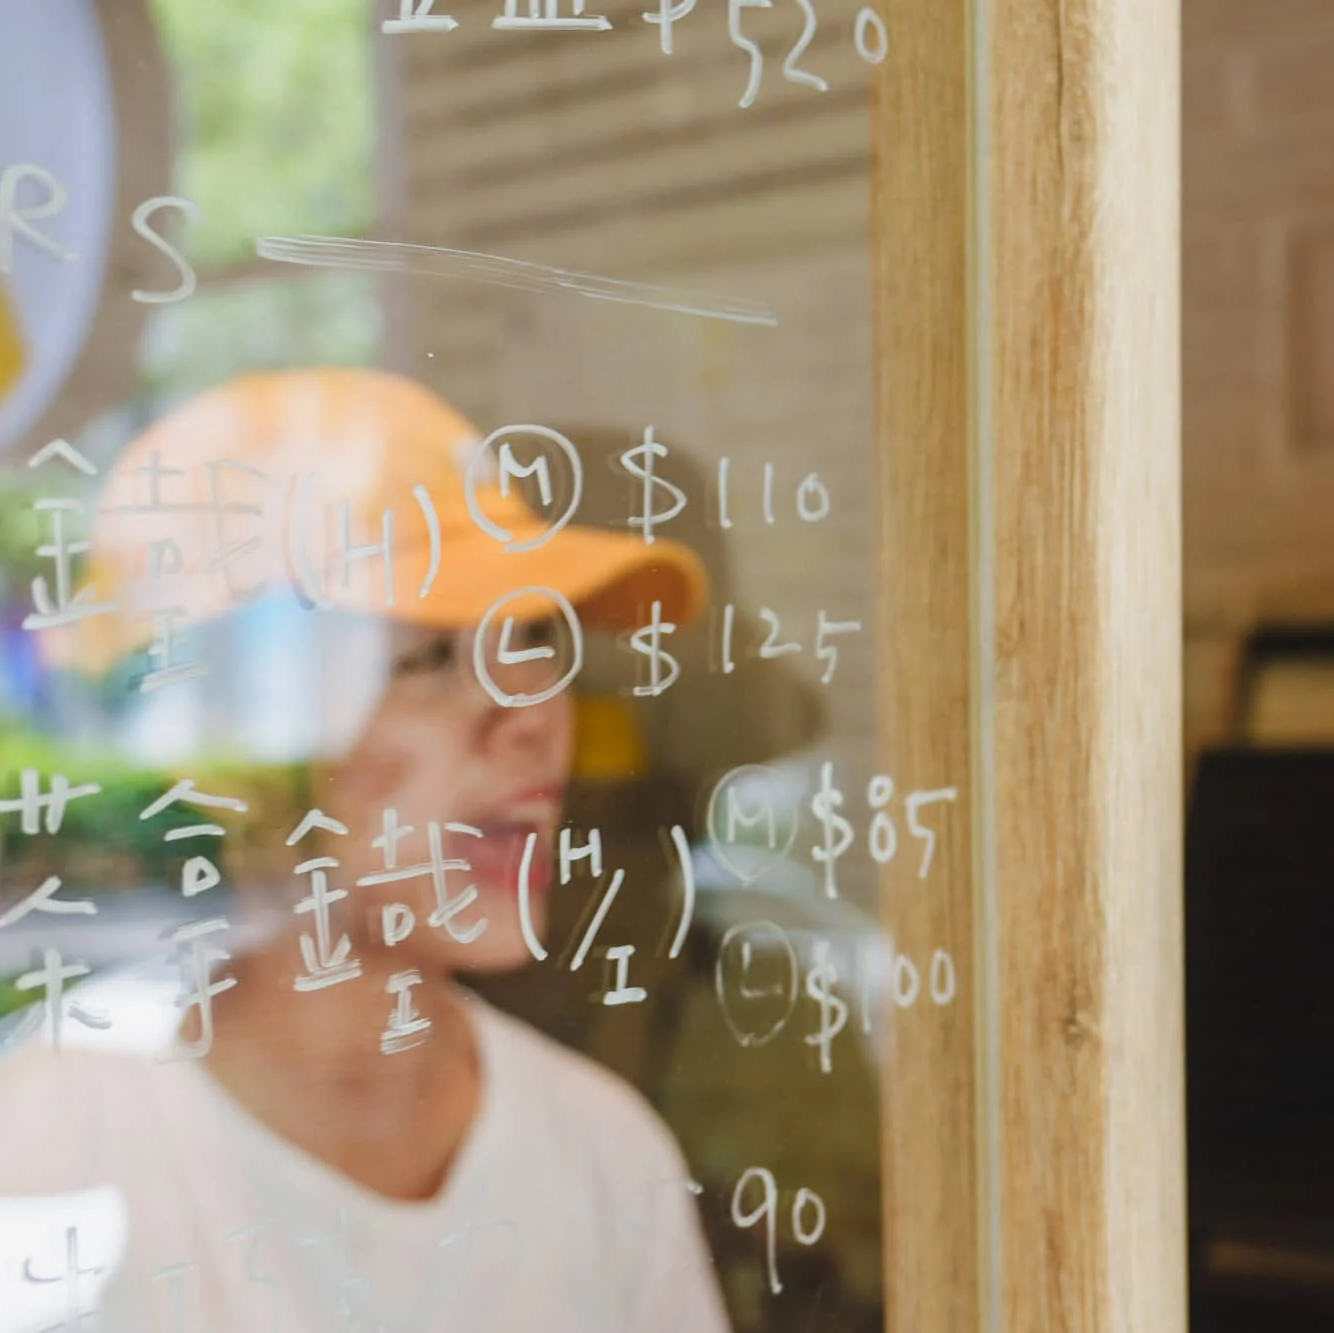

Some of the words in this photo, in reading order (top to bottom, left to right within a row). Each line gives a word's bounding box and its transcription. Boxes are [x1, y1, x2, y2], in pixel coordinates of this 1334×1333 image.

[619, 424, 833, 544] $110
[628, 600, 863, 698] $125
[809, 761, 959, 900] $85
